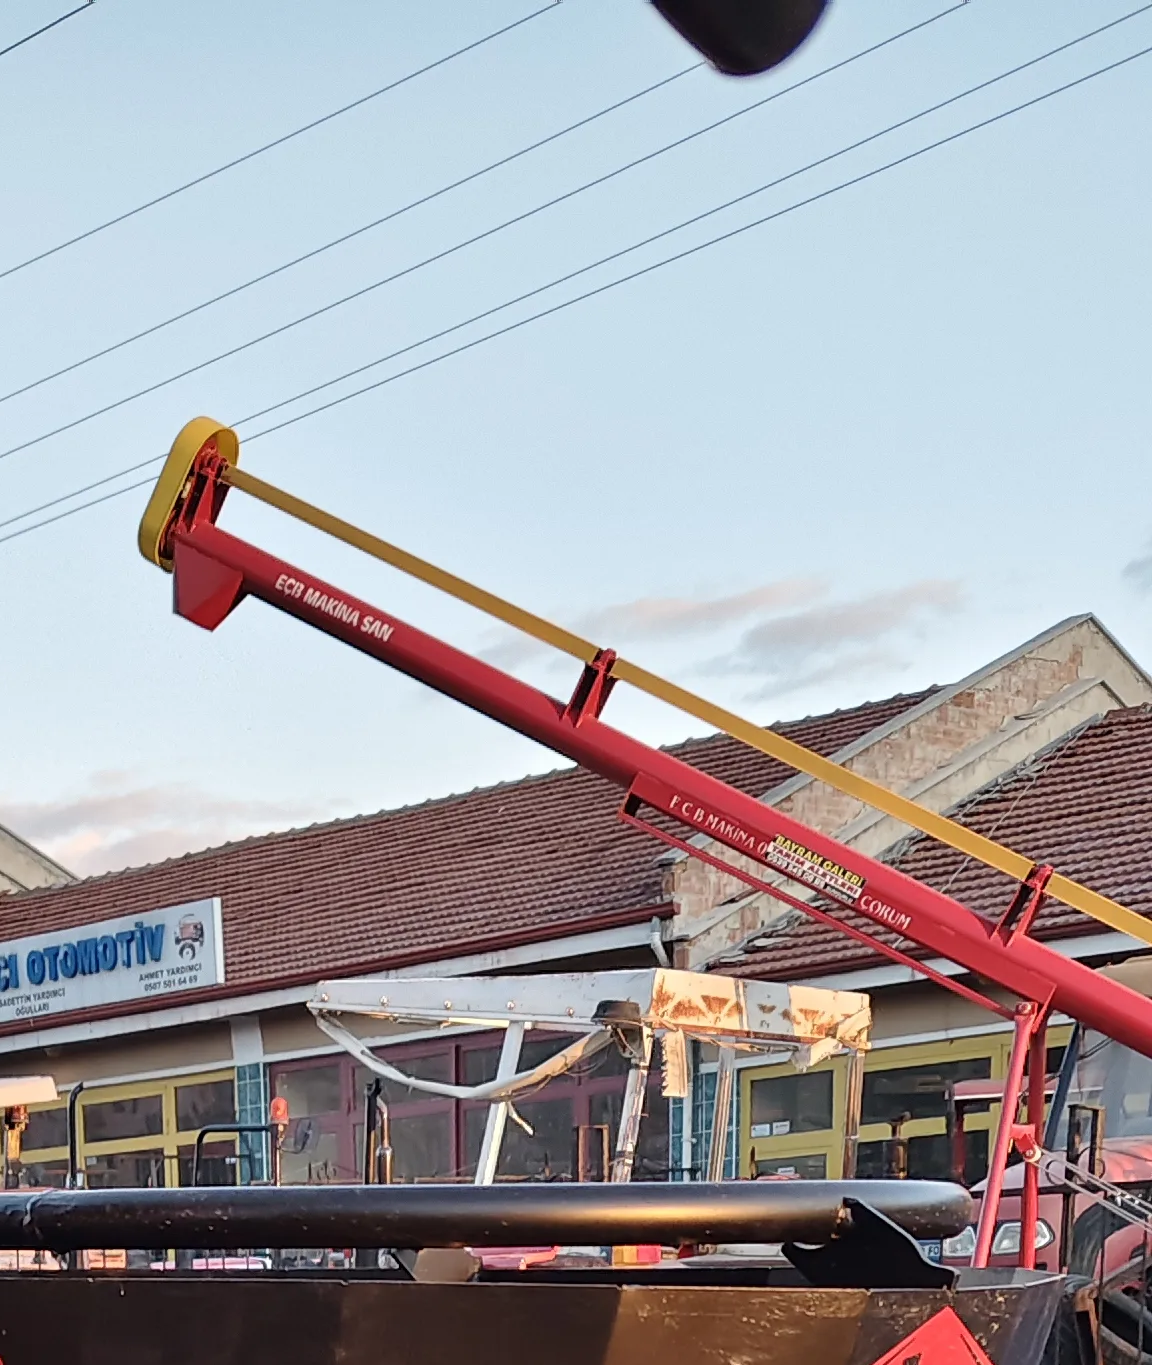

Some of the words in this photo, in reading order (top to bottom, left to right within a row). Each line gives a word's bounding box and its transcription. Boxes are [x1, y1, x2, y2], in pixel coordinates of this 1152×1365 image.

[360, 615, 395, 642] SAN
[775, 835, 824, 866] BAYRAM
[822, 860, 864, 887] GALERİ
[859, 894, 912, 931] ÇORUM
[26, 921, 166, 986] OTOMOTİV
[138, 970, 164, 982] AHMET
